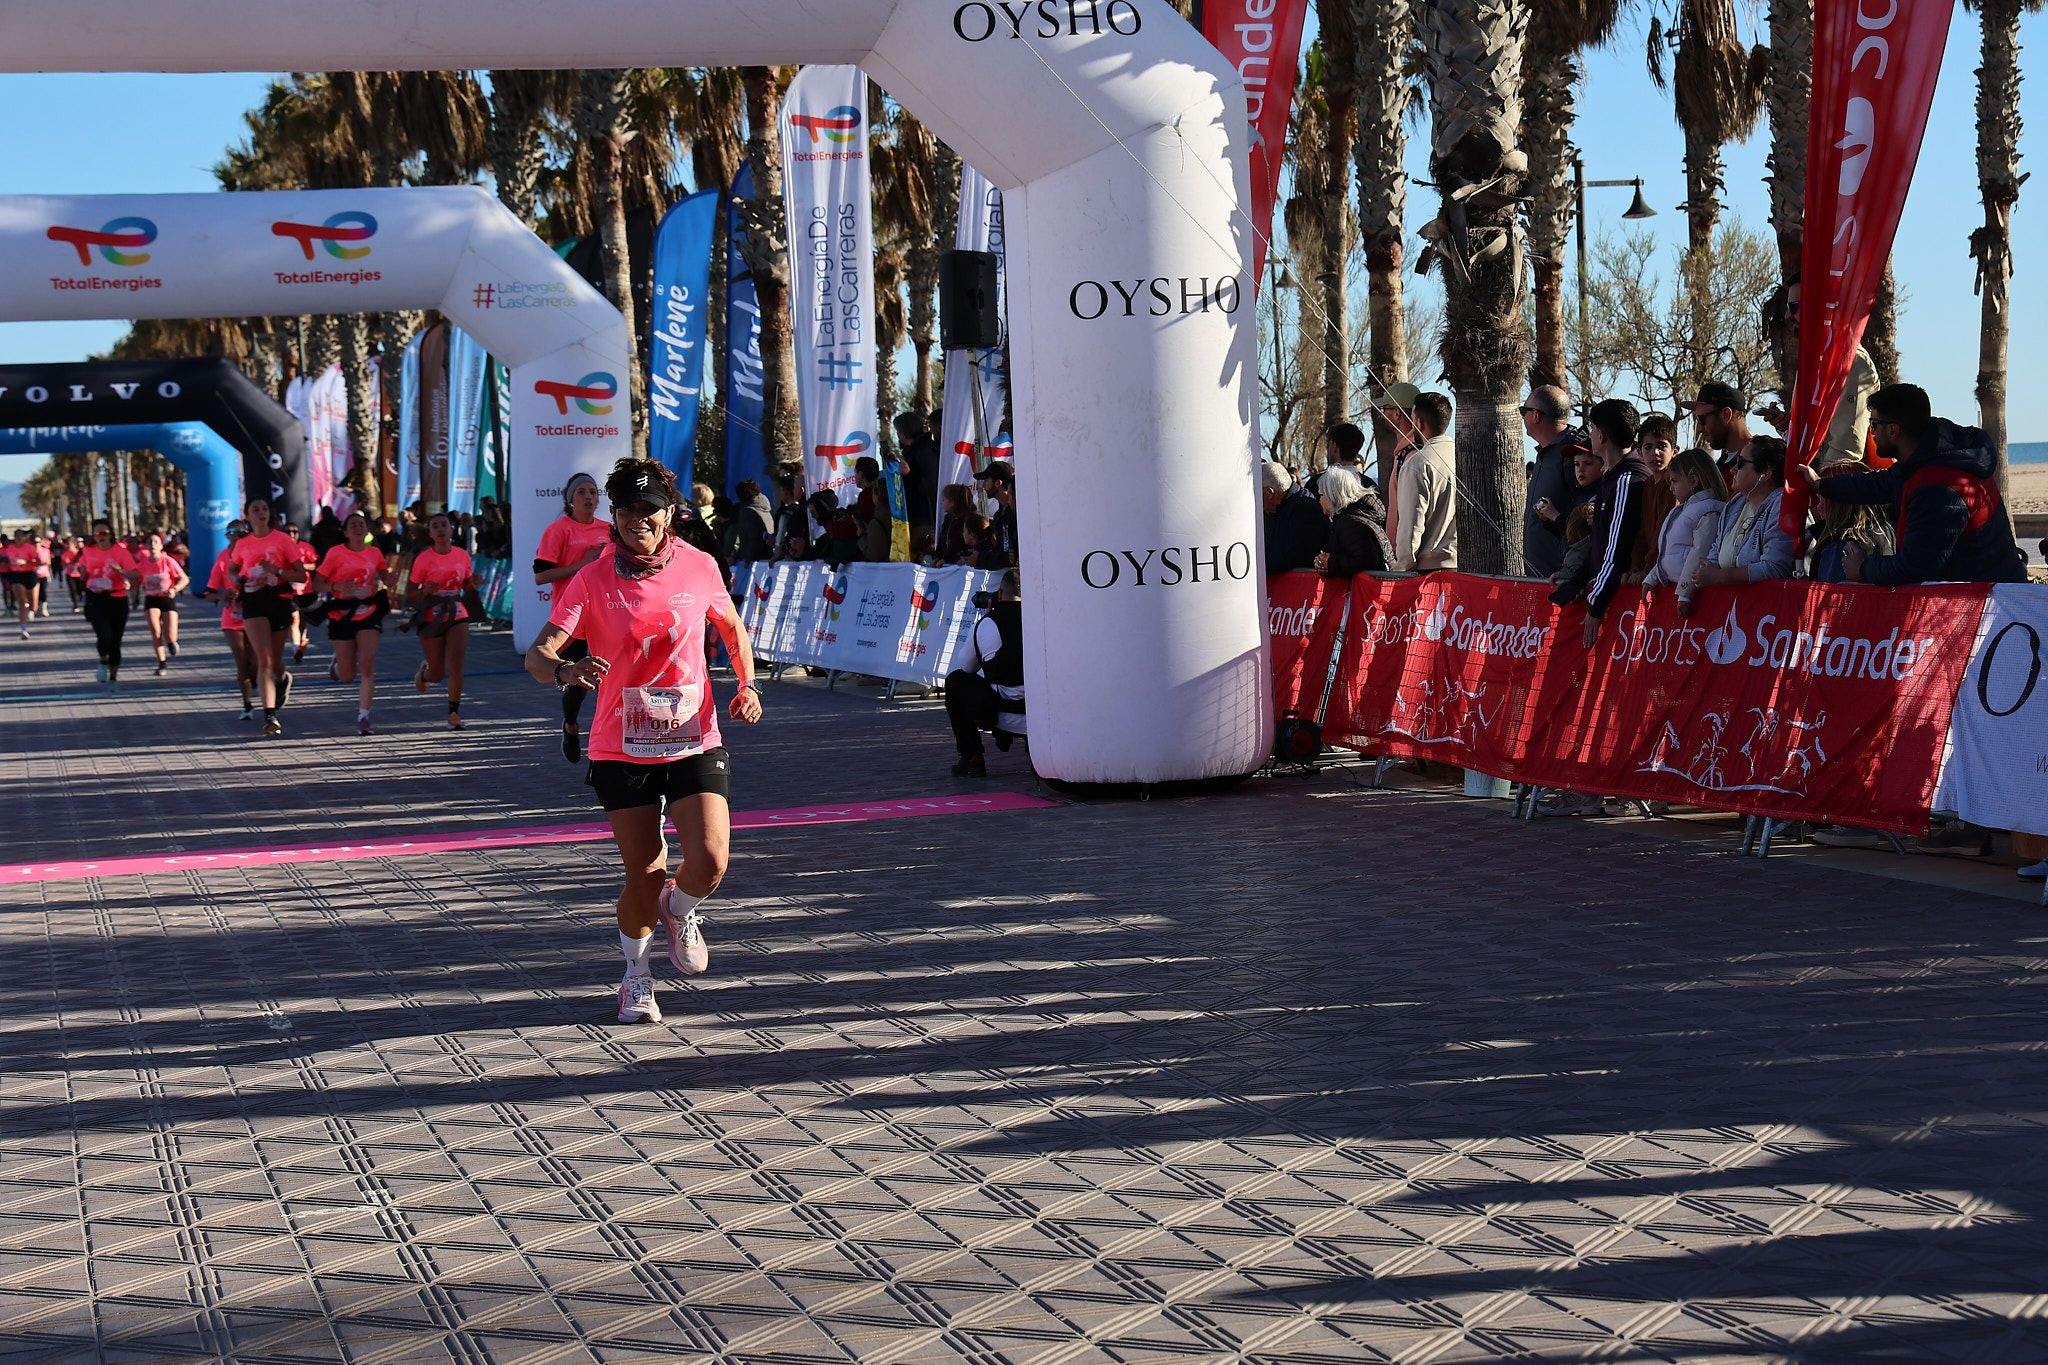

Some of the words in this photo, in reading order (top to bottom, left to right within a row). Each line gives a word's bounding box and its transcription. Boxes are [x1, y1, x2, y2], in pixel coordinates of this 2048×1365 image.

[953, 0, 1142, 42] OYSHO
[792, 149, 864, 163] TotalEnergies
[50, 276, 162, 291] TotalEnergies
[274, 269, 381, 285] TotalEnergies
[838, 203, 861, 346] LasCarreras
[1069, 275, 1240, 320] OYSHO
[534, 424, 620, 438] TotalEnergies
[816, 474, 857, 492] TotalEnerg
[1081, 541, 1251, 589] OYSHO
[1361, 604, 1424, 655] Sports
[1444, 604, 1551, 659] Santander
[1611, 610, 1705, 675] Sports
[1748, 613, 1934, 681] Santander
